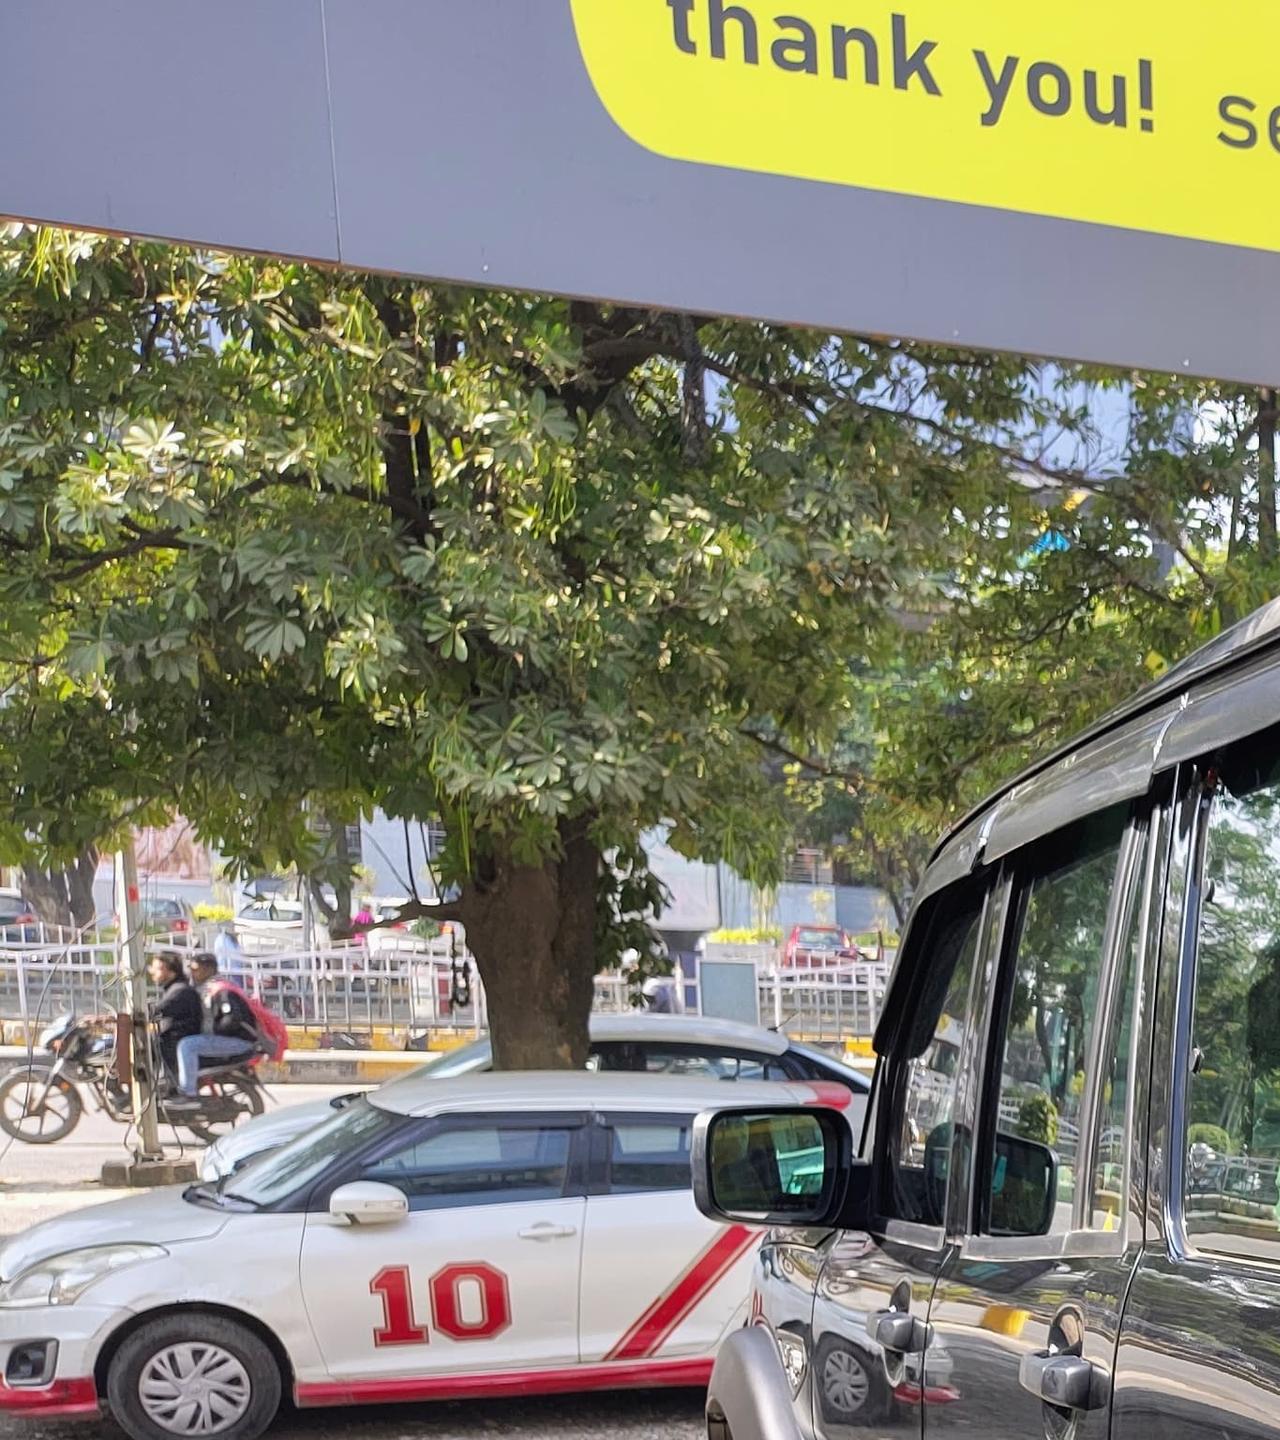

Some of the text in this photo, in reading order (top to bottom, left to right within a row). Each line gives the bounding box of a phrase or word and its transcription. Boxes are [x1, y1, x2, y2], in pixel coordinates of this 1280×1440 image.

[667, 0, 943, 96] thank
[973, 45, 1155, 133] you!
[368, 1260, 512, 1348] 10
